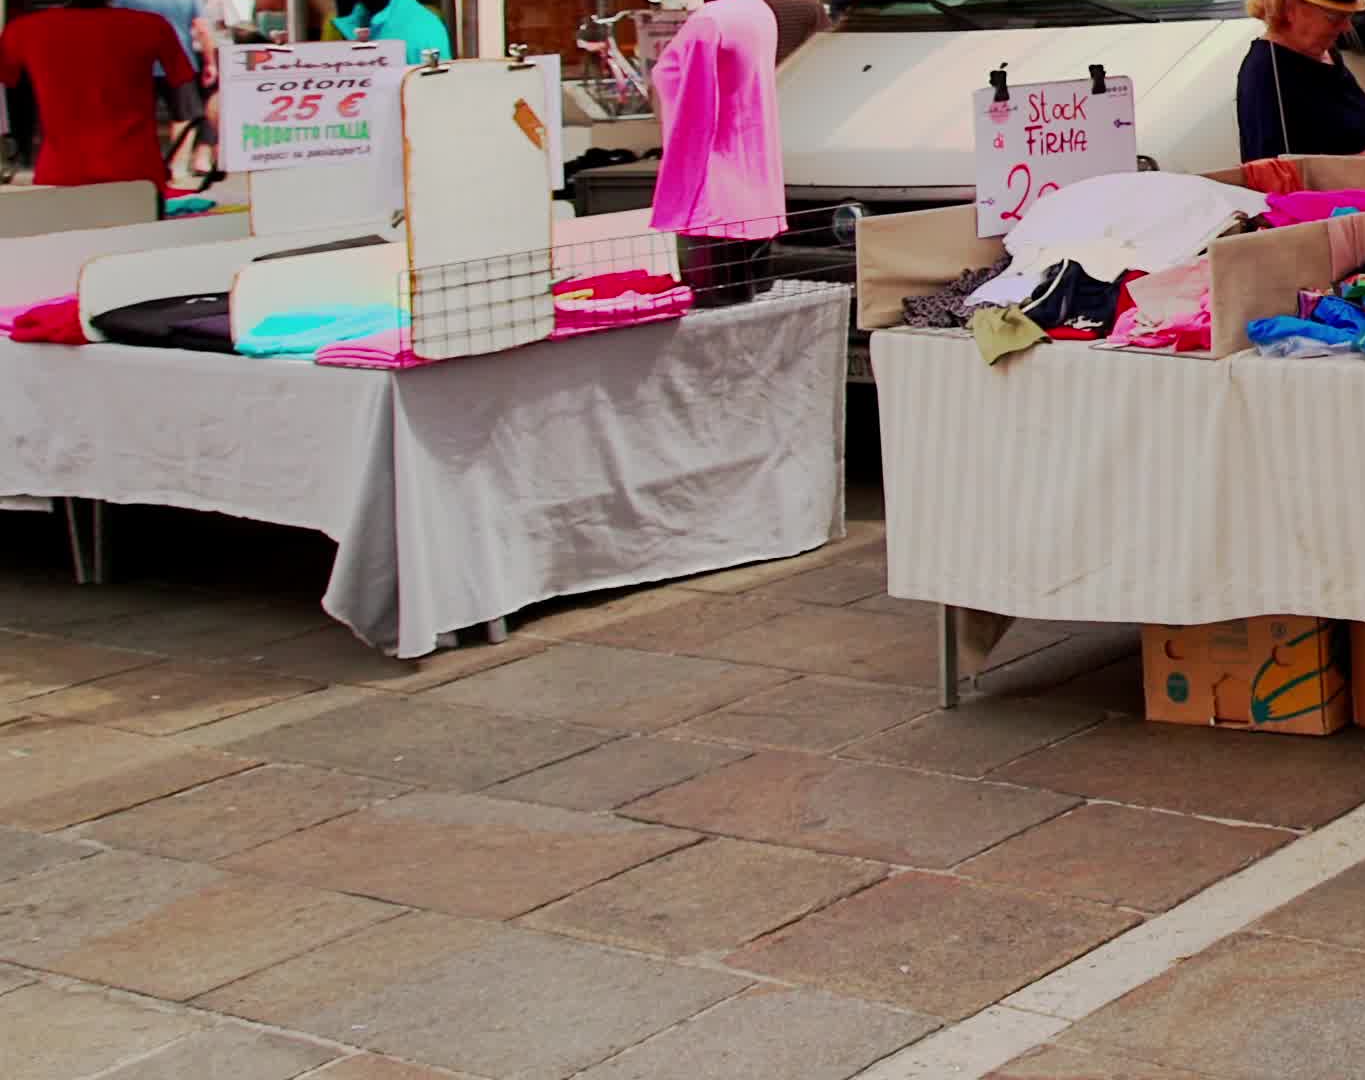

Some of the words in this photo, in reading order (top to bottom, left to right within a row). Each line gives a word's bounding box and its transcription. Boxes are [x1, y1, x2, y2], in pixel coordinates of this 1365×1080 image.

[257, 78, 373, 93] cotone
[263, 94, 325, 122] 25
[337, 92, 368, 117] €
[1000, 162, 1060, 221] 2
